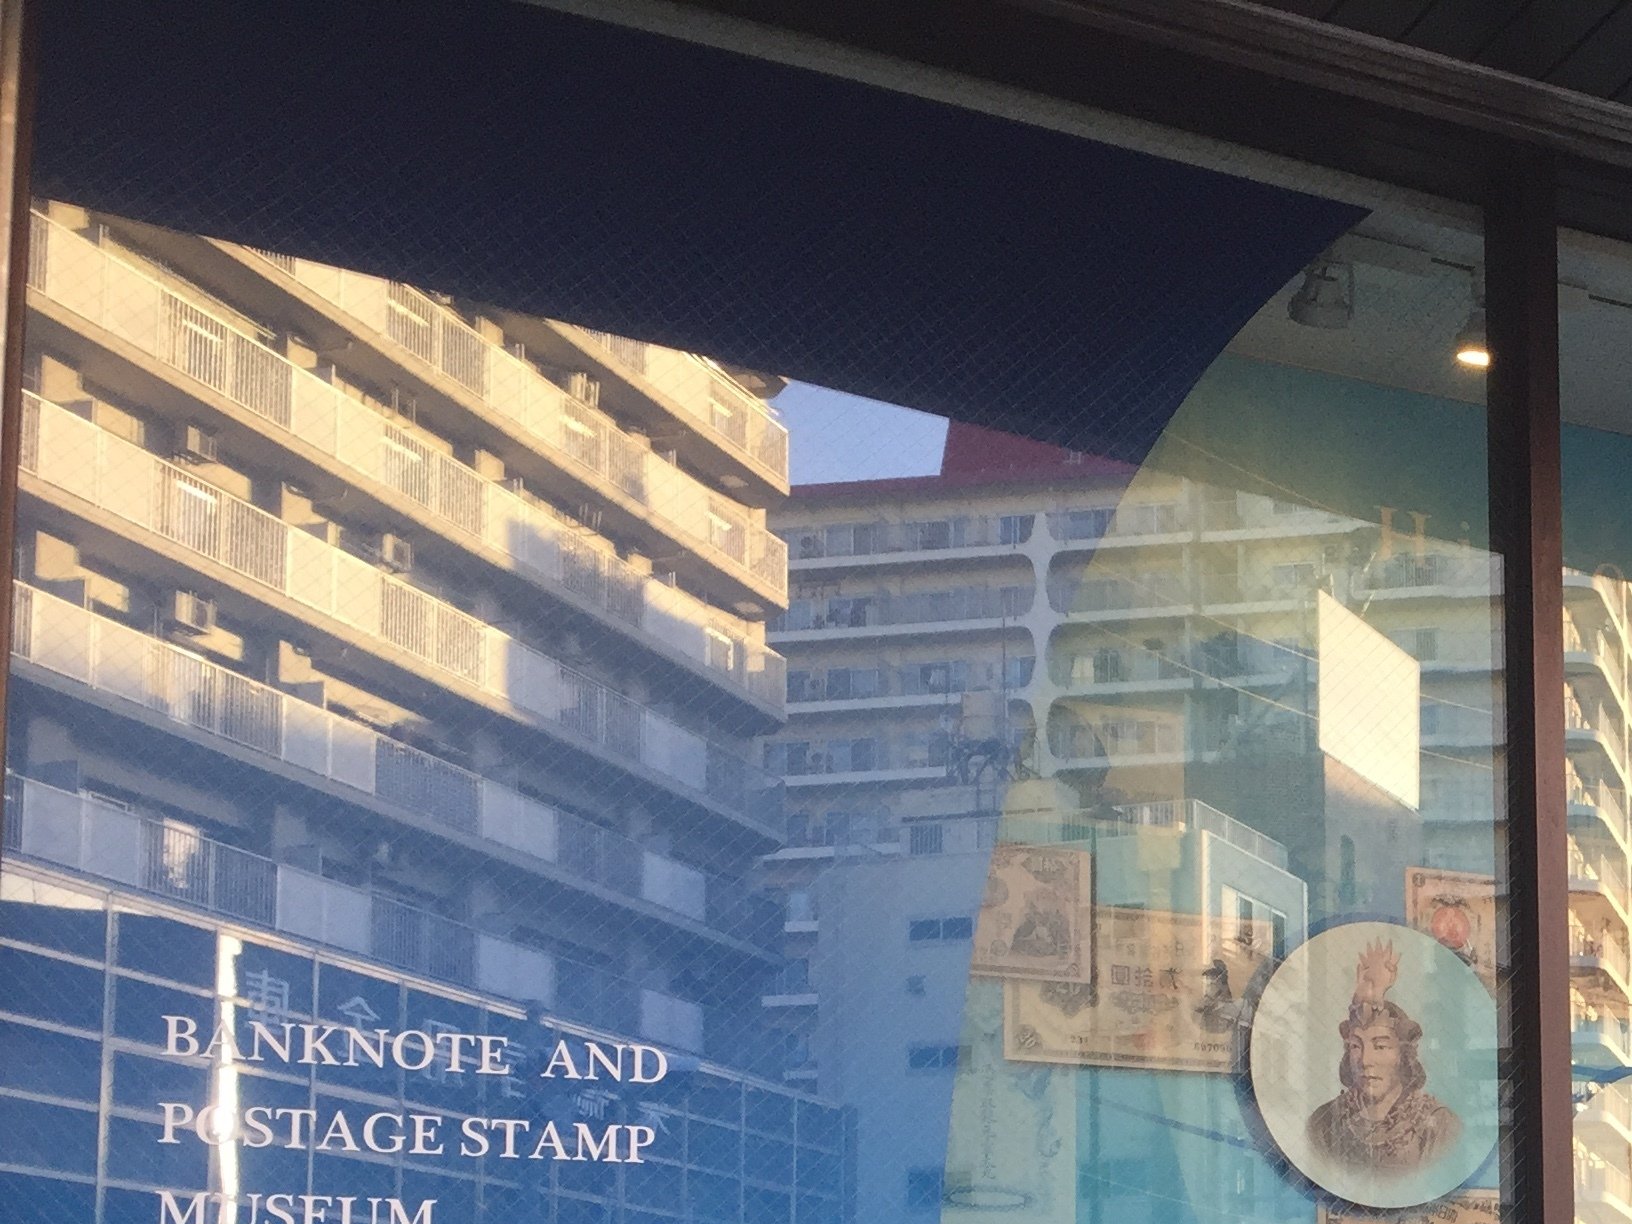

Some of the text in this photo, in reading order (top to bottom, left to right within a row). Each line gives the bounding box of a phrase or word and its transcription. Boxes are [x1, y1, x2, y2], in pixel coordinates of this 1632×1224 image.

[161, 1015, 669, 1085] BANKNOTE AND
[157, 1102, 656, 1164] POSTAGE STAMP
